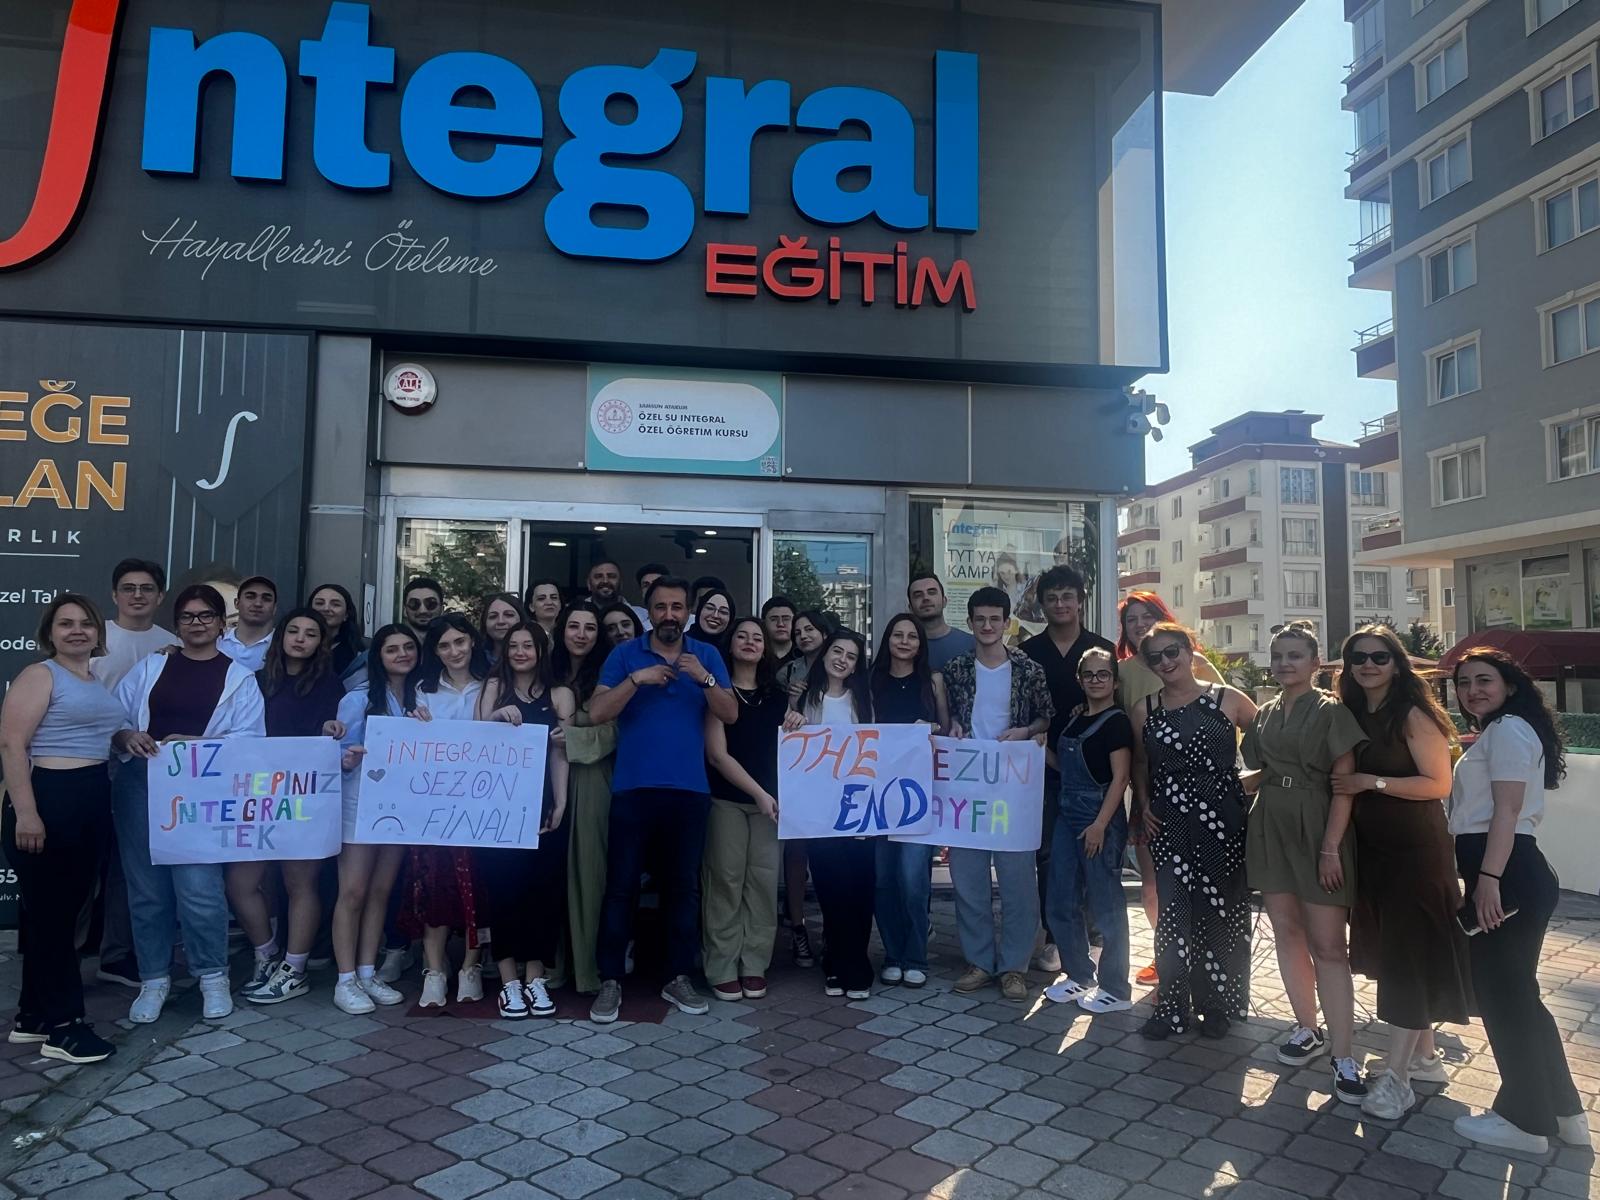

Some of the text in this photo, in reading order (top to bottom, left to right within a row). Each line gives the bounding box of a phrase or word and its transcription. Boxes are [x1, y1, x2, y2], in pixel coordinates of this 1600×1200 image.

[142, 217, 498, 280] Hayallerini Öteleme
[706, 235, 977, 311] EĞİTİM
[638, 410, 663, 421] ÖZEL
[665, 413, 677, 422] SU
[638, 423, 664, 434] ÖZEL
[715, 428, 748, 438] KURSU
[0, 459, 127, 511] AN
[781, 727, 880, 780] THE
[931, 748, 1031, 785] EZUN
[833, 776, 928, 833] END
[931, 793, 1009, 836] AYFA
[212, 824, 276, 850] TEK
